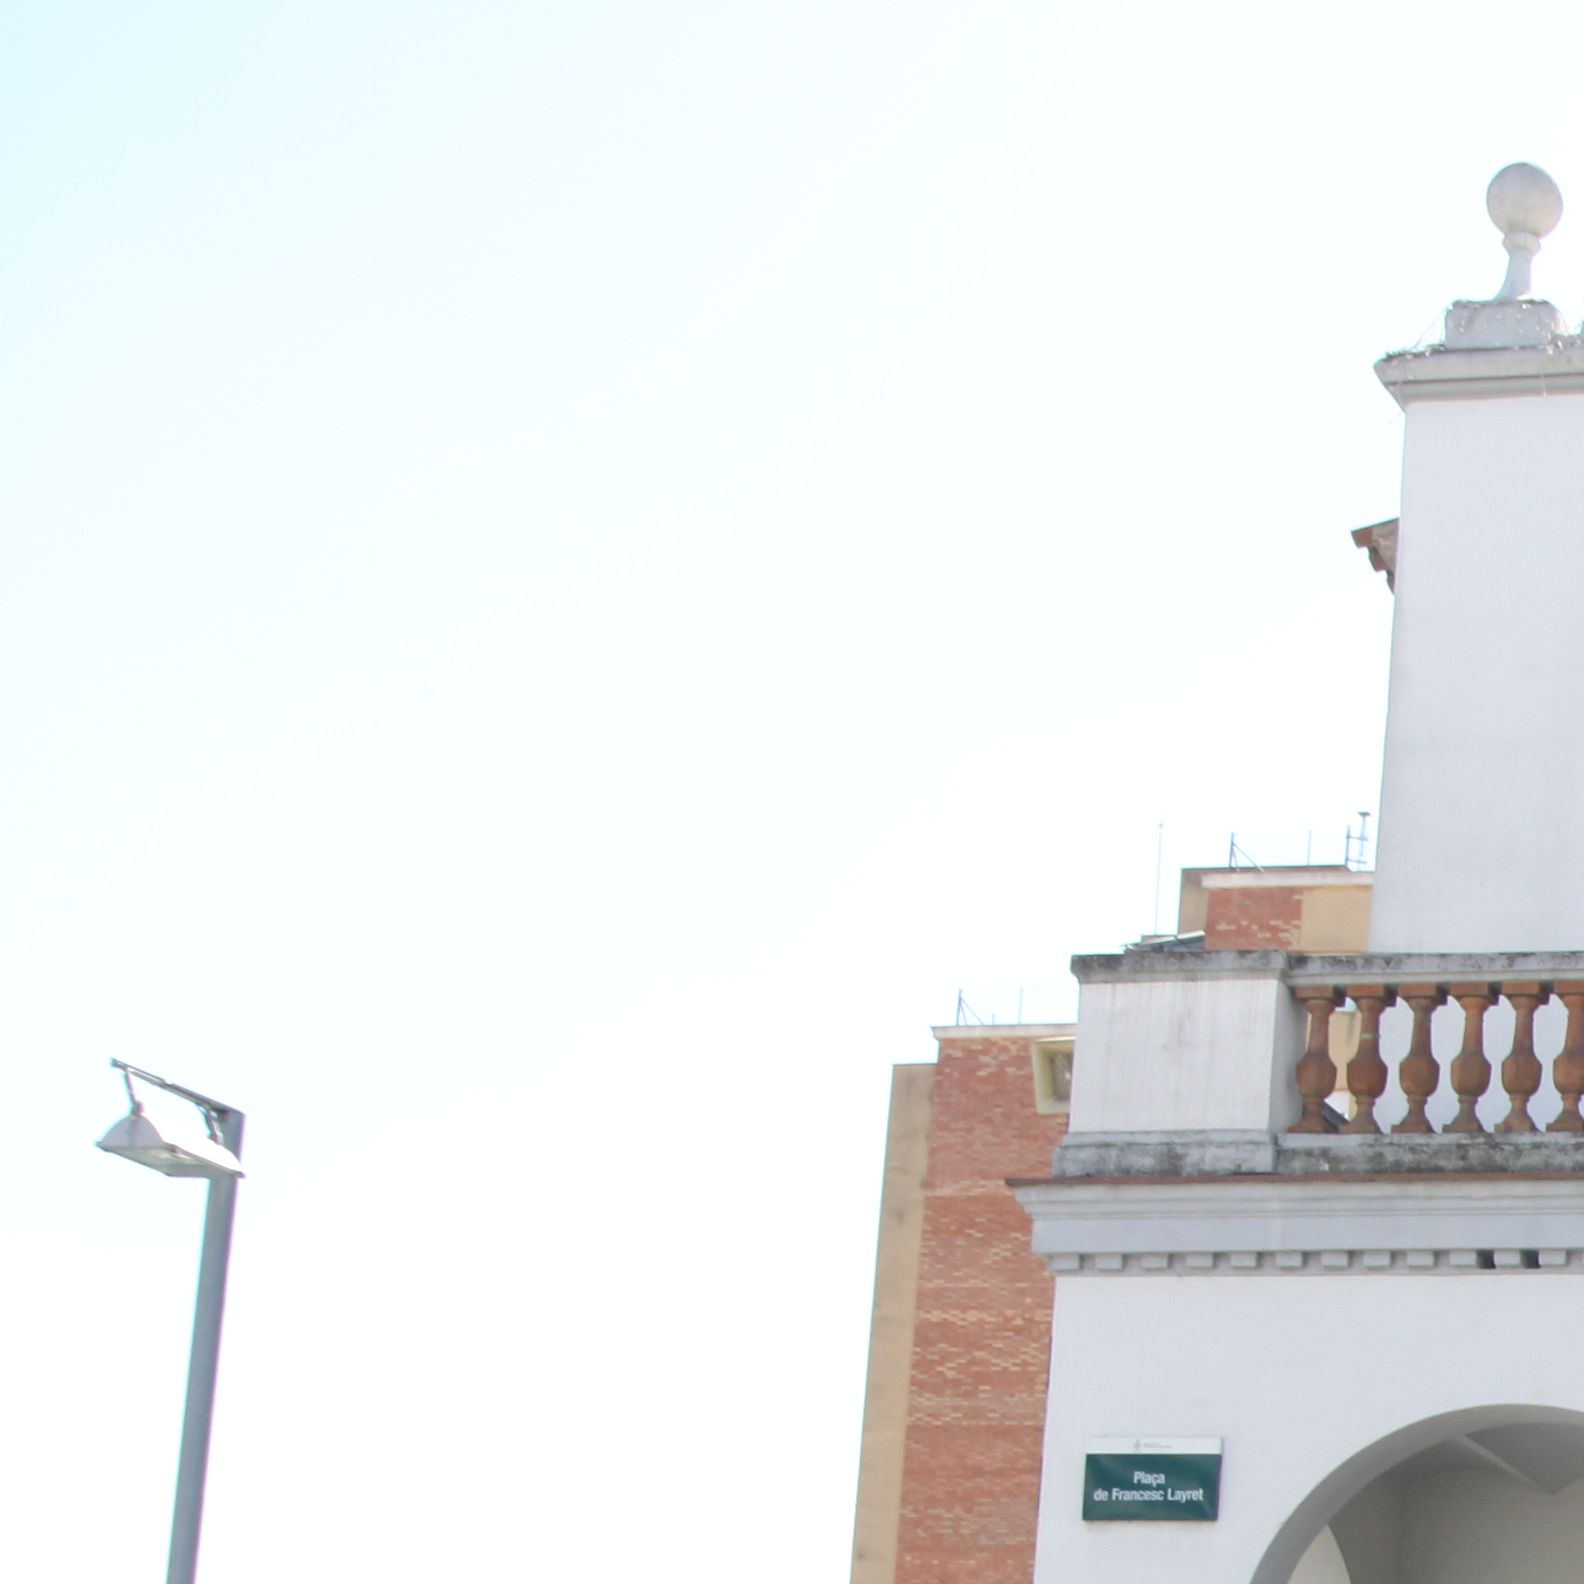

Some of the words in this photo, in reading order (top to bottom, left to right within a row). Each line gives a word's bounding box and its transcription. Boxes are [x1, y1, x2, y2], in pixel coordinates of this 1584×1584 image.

[1133, 1471, 1165, 1487] Plaça
[1094, 1488, 1109, 1501] de
[1112, 1488, 1165, 1501] Francesc
[1168, 1488, 1204, 1503] Layret
